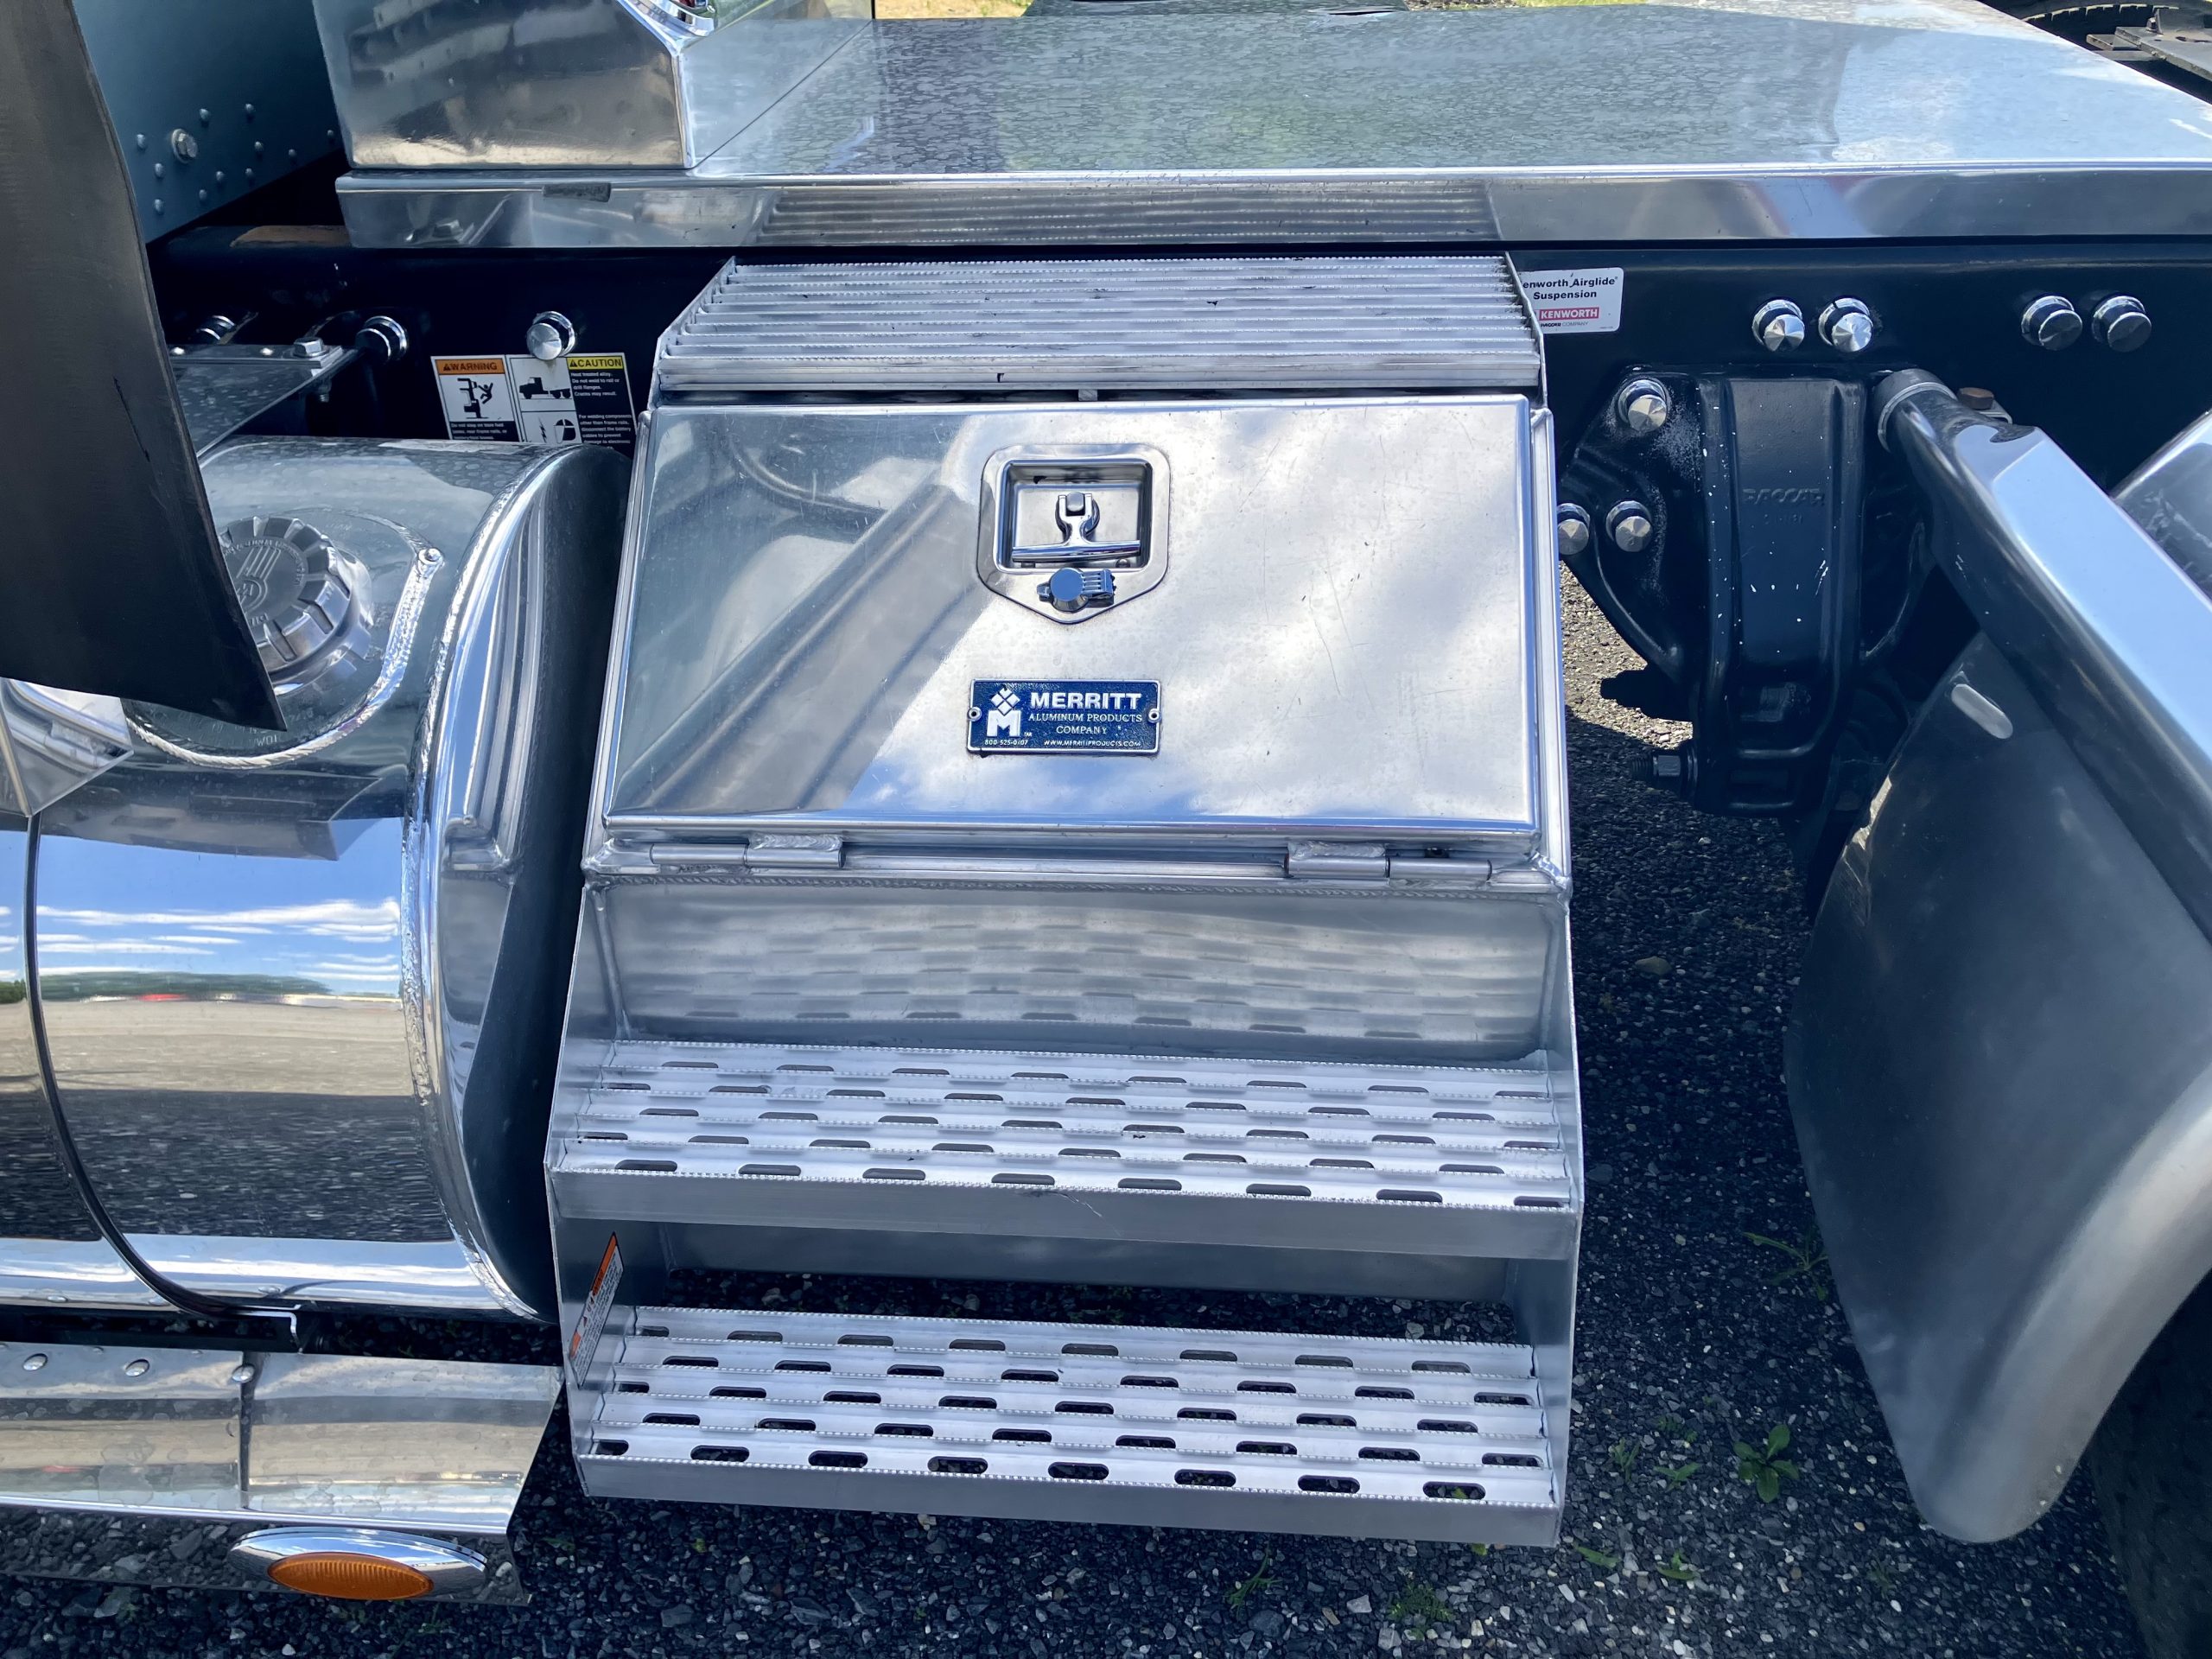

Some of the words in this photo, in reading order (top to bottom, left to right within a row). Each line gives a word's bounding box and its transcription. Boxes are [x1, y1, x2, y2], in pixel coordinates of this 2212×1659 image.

[1521, 278, 1568, 289] enworth
[1533, 290, 1597, 301] Suspension
[1541, 309, 1598, 319] KENWORTH
[450, 359, 498, 371] WARNING
[577, 358, 622, 368] CAUTION
[1030, 692, 1142, 710] MERRITT
[1028, 714, 1084, 722] ALUMINUM
[1086, 714, 1143, 723] PRODUCTS
[1056, 725, 1108, 734] COMPANY
